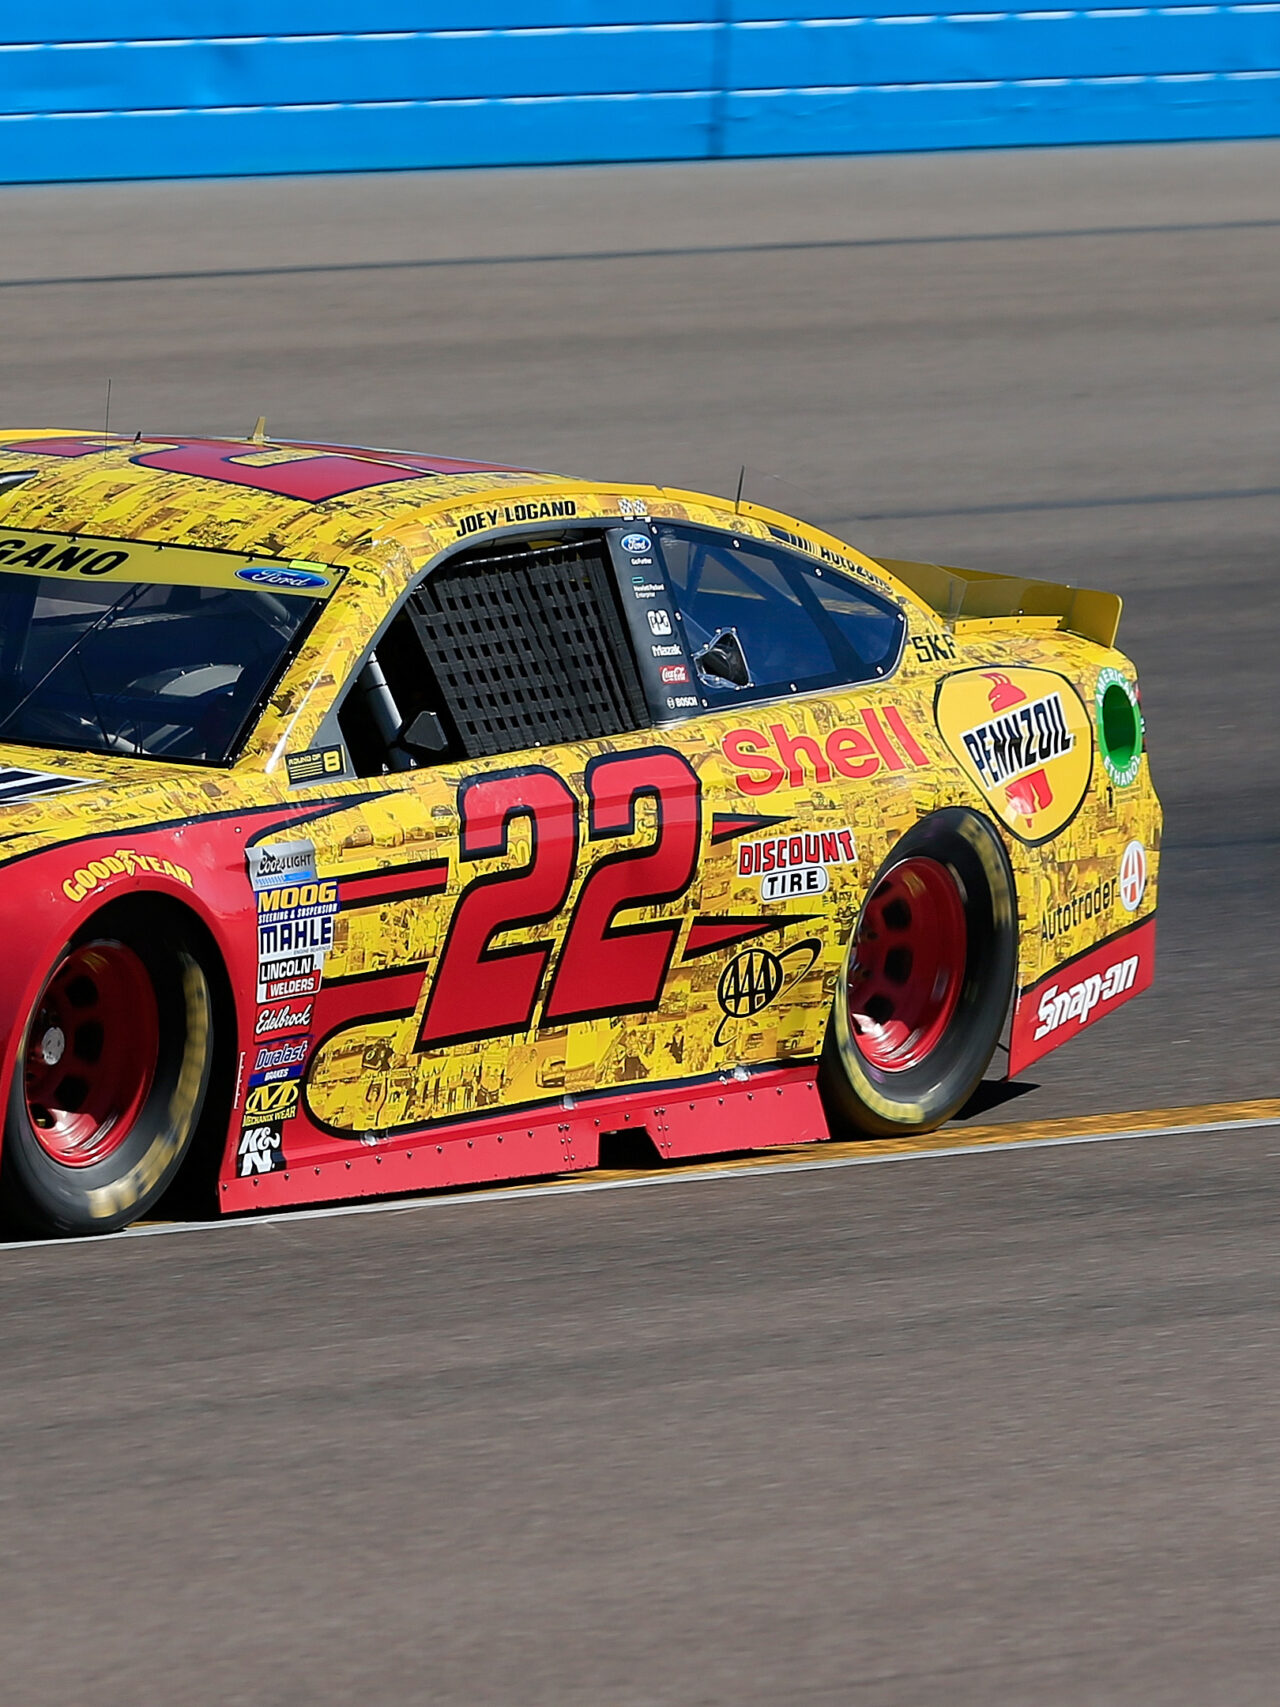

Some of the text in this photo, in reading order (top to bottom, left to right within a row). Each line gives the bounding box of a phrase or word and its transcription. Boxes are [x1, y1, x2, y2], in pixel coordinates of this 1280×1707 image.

[457, 500, 577, 537] JOEY LOGANO
[251, 571, 311, 587] Ford
[912, 633, 956, 663] SKF
[675, 696, 698, 708] BOSCH
[1096, 667, 1137, 707] AMERICAN
[721, 705, 930, 796] Shell
[963, 695, 1072, 788] PENNZOIL
[323, 750, 341, 772] 8
[1103, 755, 1141, 787] ETHANOL
[286, 854, 311, 869] LIGHT
[738, 830, 855, 875] DISCOUNT
[62, 849, 194, 902] GOODYEAR
[767, 870, 819, 896] TIRE
[258, 881, 338, 913] MOOG
[412, 745, 702, 1055] 22
[1042, 875, 1118, 942] Autotrader
[258, 903, 338, 925] STEERING & SUSPENSION
[260, 916, 332, 955] MAHLE
[261, 957, 312, 982] LINCOLN
[721, 948, 780, 1016] AAA
[270, 977, 315, 997] WELDERS
[1034, 956, 1139, 1040] Snap-on
[255, 1004, 312, 1034] Edelbrock
[254, 1040, 308, 1070] Duralast
[264, 1067, 289, 1081] BRAKES
[274, 1105, 297, 1121] WEAR
